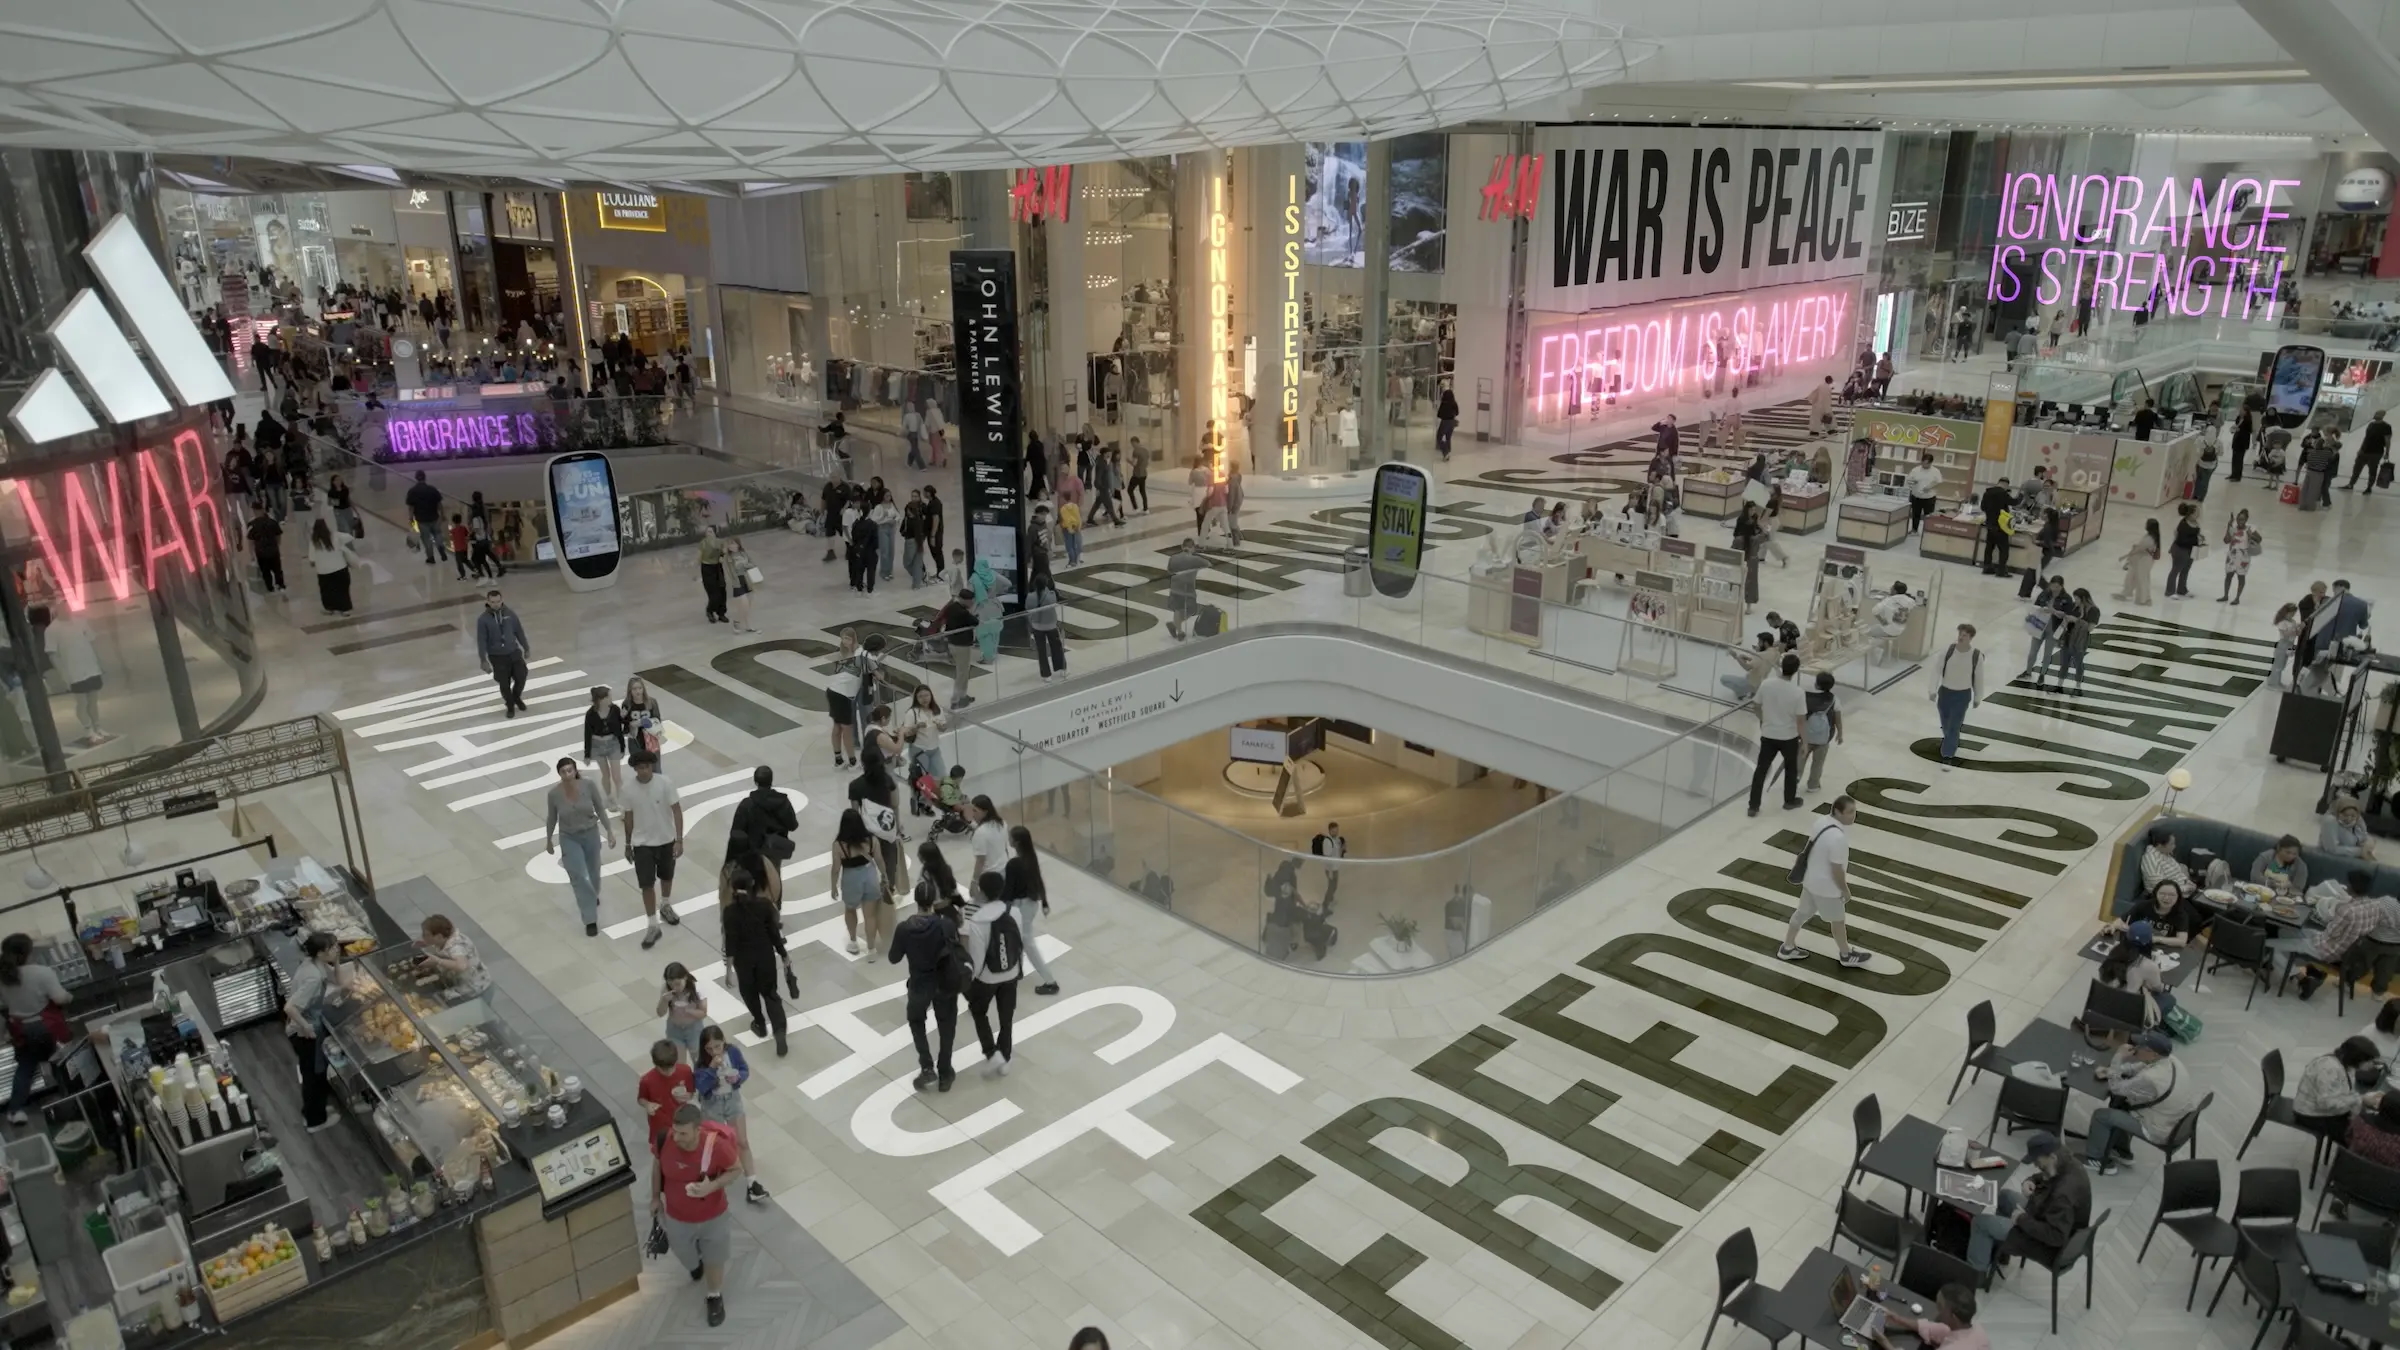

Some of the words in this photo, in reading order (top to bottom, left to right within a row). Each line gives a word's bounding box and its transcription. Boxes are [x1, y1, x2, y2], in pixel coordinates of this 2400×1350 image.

[1284, 175, 1300, 235] IS
[1479, 153, 1545, 222] H&M
[1553, 148, 1669, 288] WAR
[1682, 147, 1730, 275] IS
[1741, 146, 1874, 269] PEACE
[1888, 208, 1928, 235] BIZE
[1997, 172, 2301, 253] IGNORANCE
[978, 266, 999, 343] JOHN
[1987, 245, 2026, 302] IS
[2036, 248, 2284, 322] STRENGTH
[969, 330, 980, 392] PARTNERS
[1210, 177, 1228, 484] IGNORANCE
[1282, 241, 1300, 471] STRENGTH
[1537, 309, 1688, 412] FREEDOM
[1684, 311, 1723, 382] IS
[1729, 292, 1848, 375] SLAVERY
[388, 414, 513, 453] IGNORANCE
[516, 413, 538, 446] IS
[984, 357, 1003, 442] LEWIS
[15, 428, 226, 612] WAR
[1381, 504, 1415, 537] STAY.
[1056, 726, 1090, 744] QUARTER
[1098, 710, 1137, 730] WESTFIELD
[1140, 700, 1166, 716] SQUARE
[1070, 704, 1098, 719] JOHN
[1101, 691, 1133, 708] LEWIS
